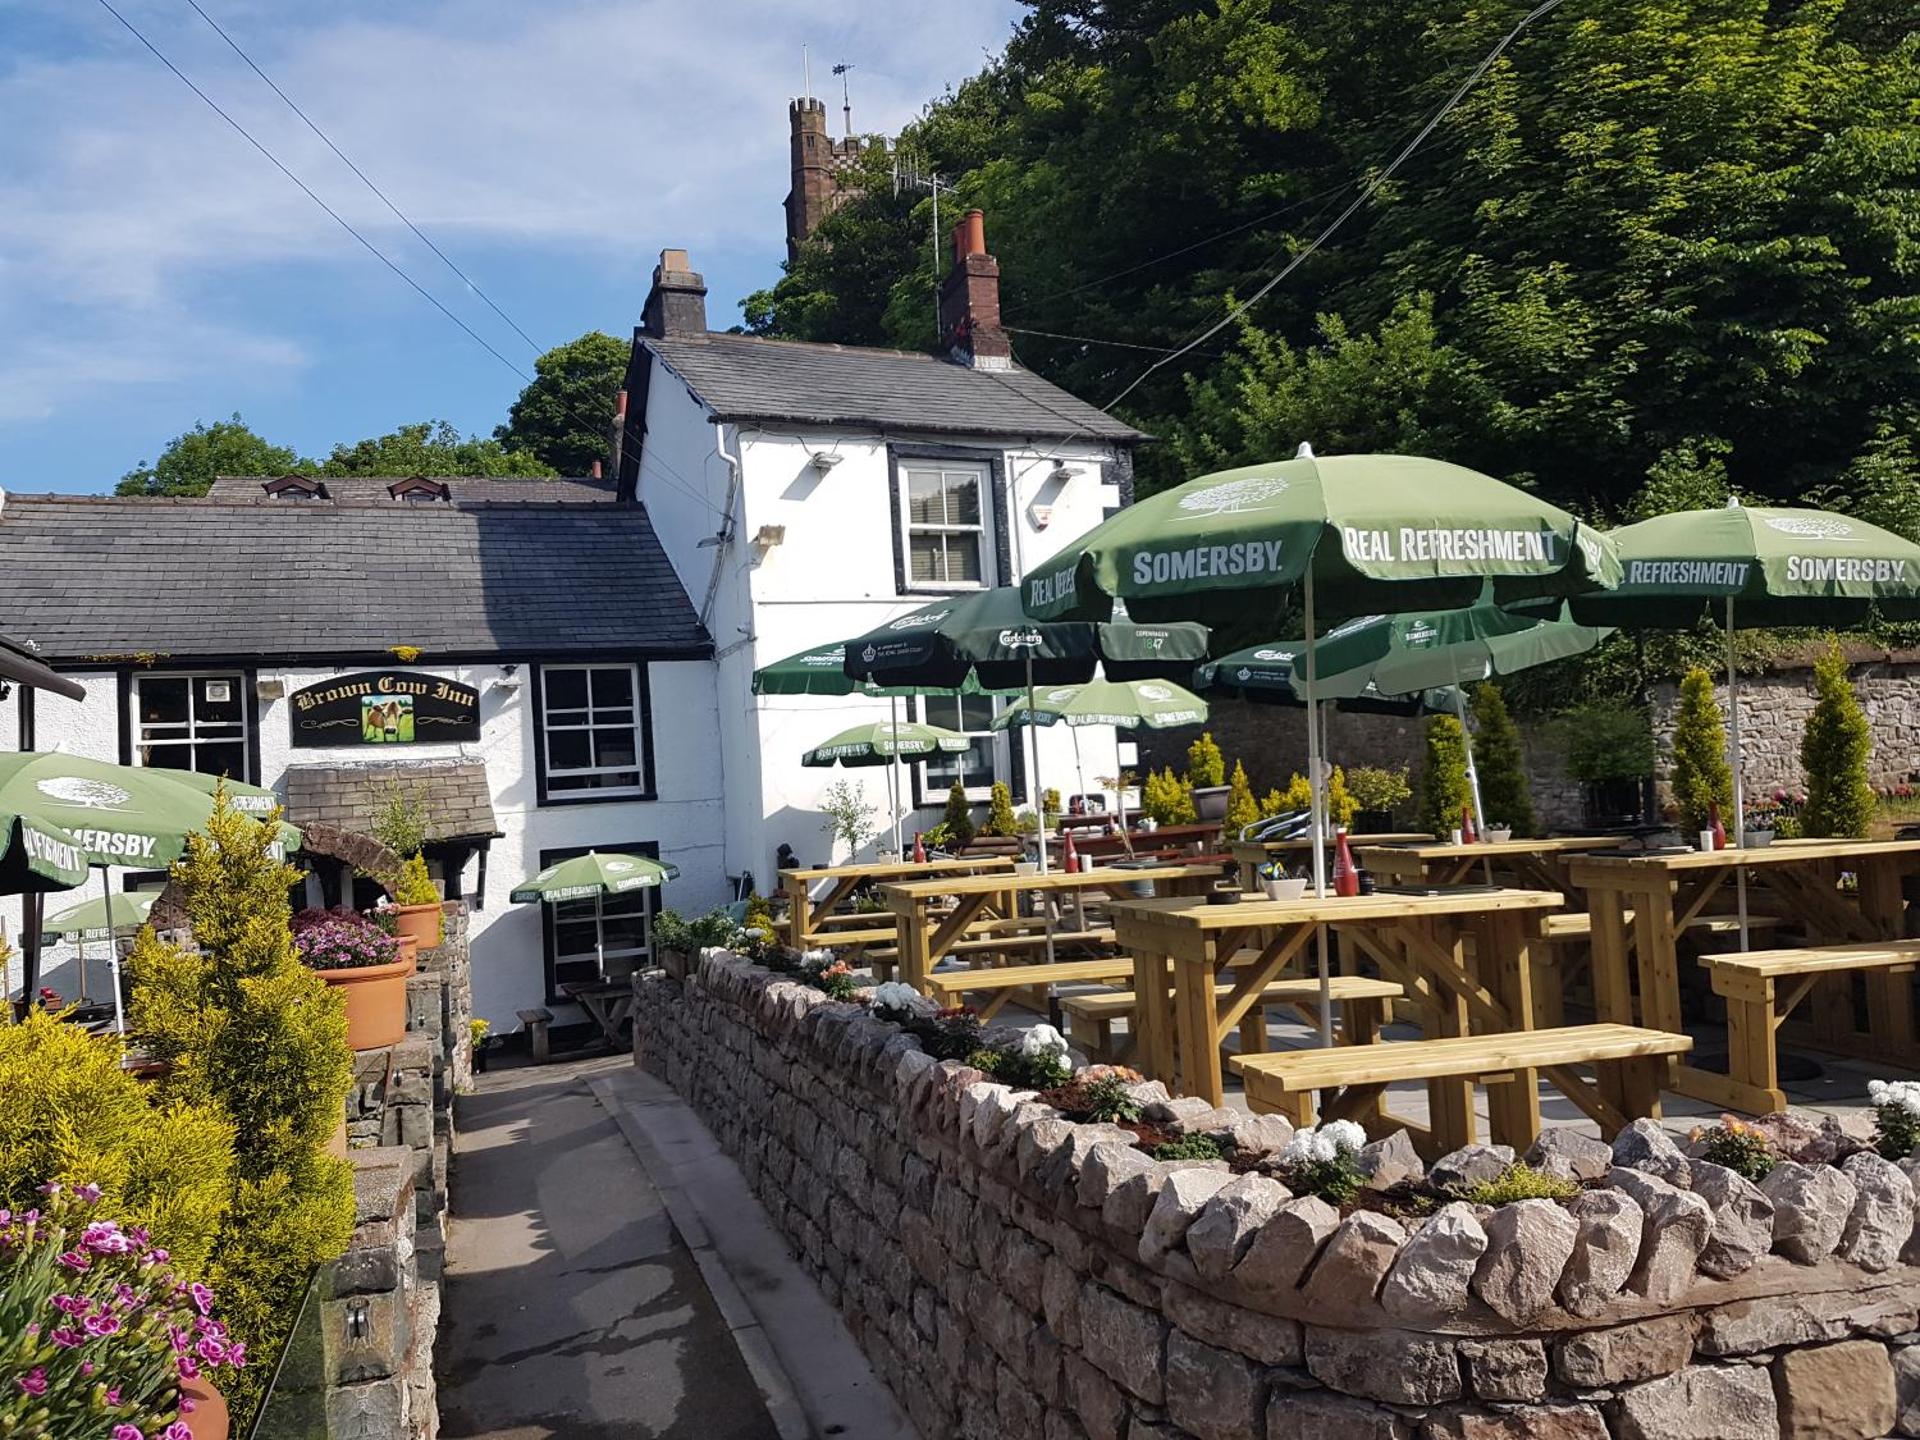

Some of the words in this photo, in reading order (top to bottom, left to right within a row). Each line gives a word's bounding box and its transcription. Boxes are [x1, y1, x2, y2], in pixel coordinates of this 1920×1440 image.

[1343, 526, 1394, 562] REAL
[1400, 527, 1558, 562] REFRESHMENT
[1630, 560, 1750, 586] REFRESHMENT
[1030, 578, 1055, 608] REAL
[1000, 629, 1042, 649] Carlsberg
[297, 681, 372, 712] Brown
[378, 676, 427, 695] Cow
[431, 681, 475, 707] Inn
[62, 827, 157, 859] MERSBY.
